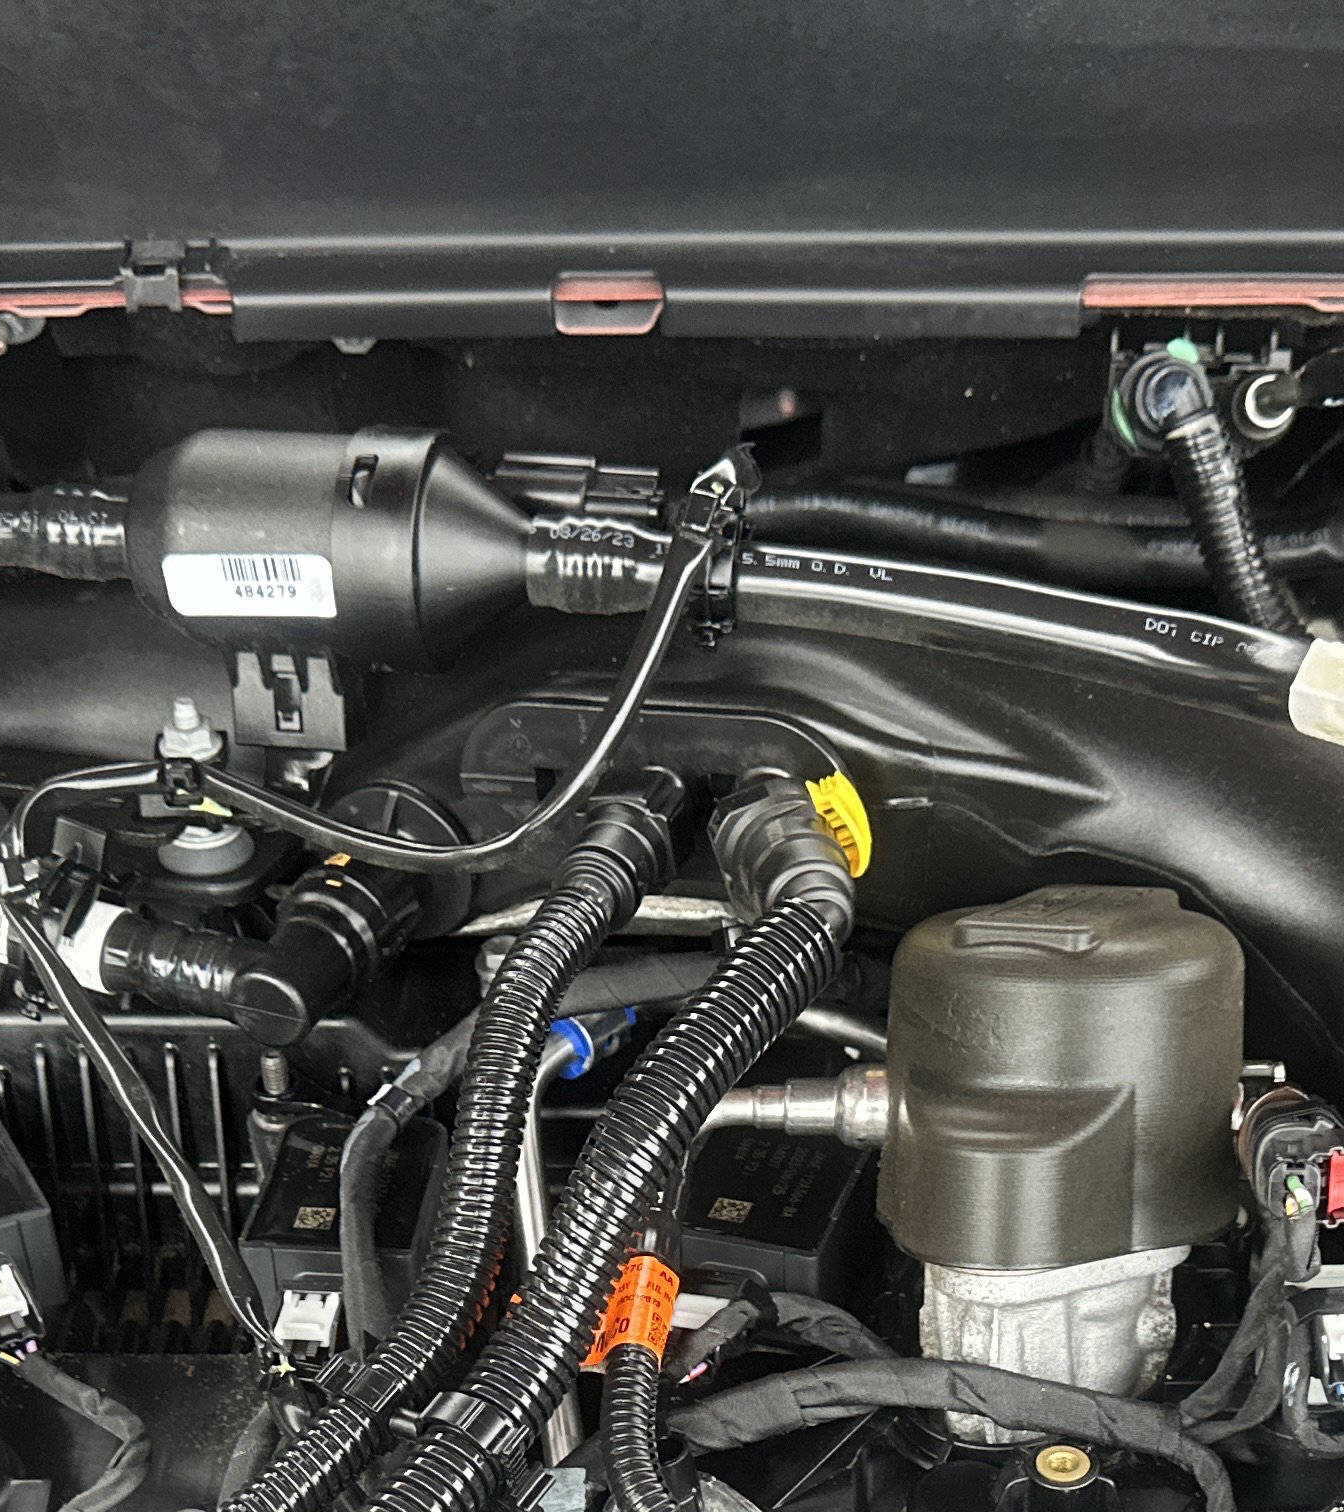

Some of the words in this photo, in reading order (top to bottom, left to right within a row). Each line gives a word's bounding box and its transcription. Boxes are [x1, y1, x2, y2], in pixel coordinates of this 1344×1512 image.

[869, 567, 893, 582] VL
[235, 585, 297, 598] 484279
[1190, 630, 1224, 647] CIP
